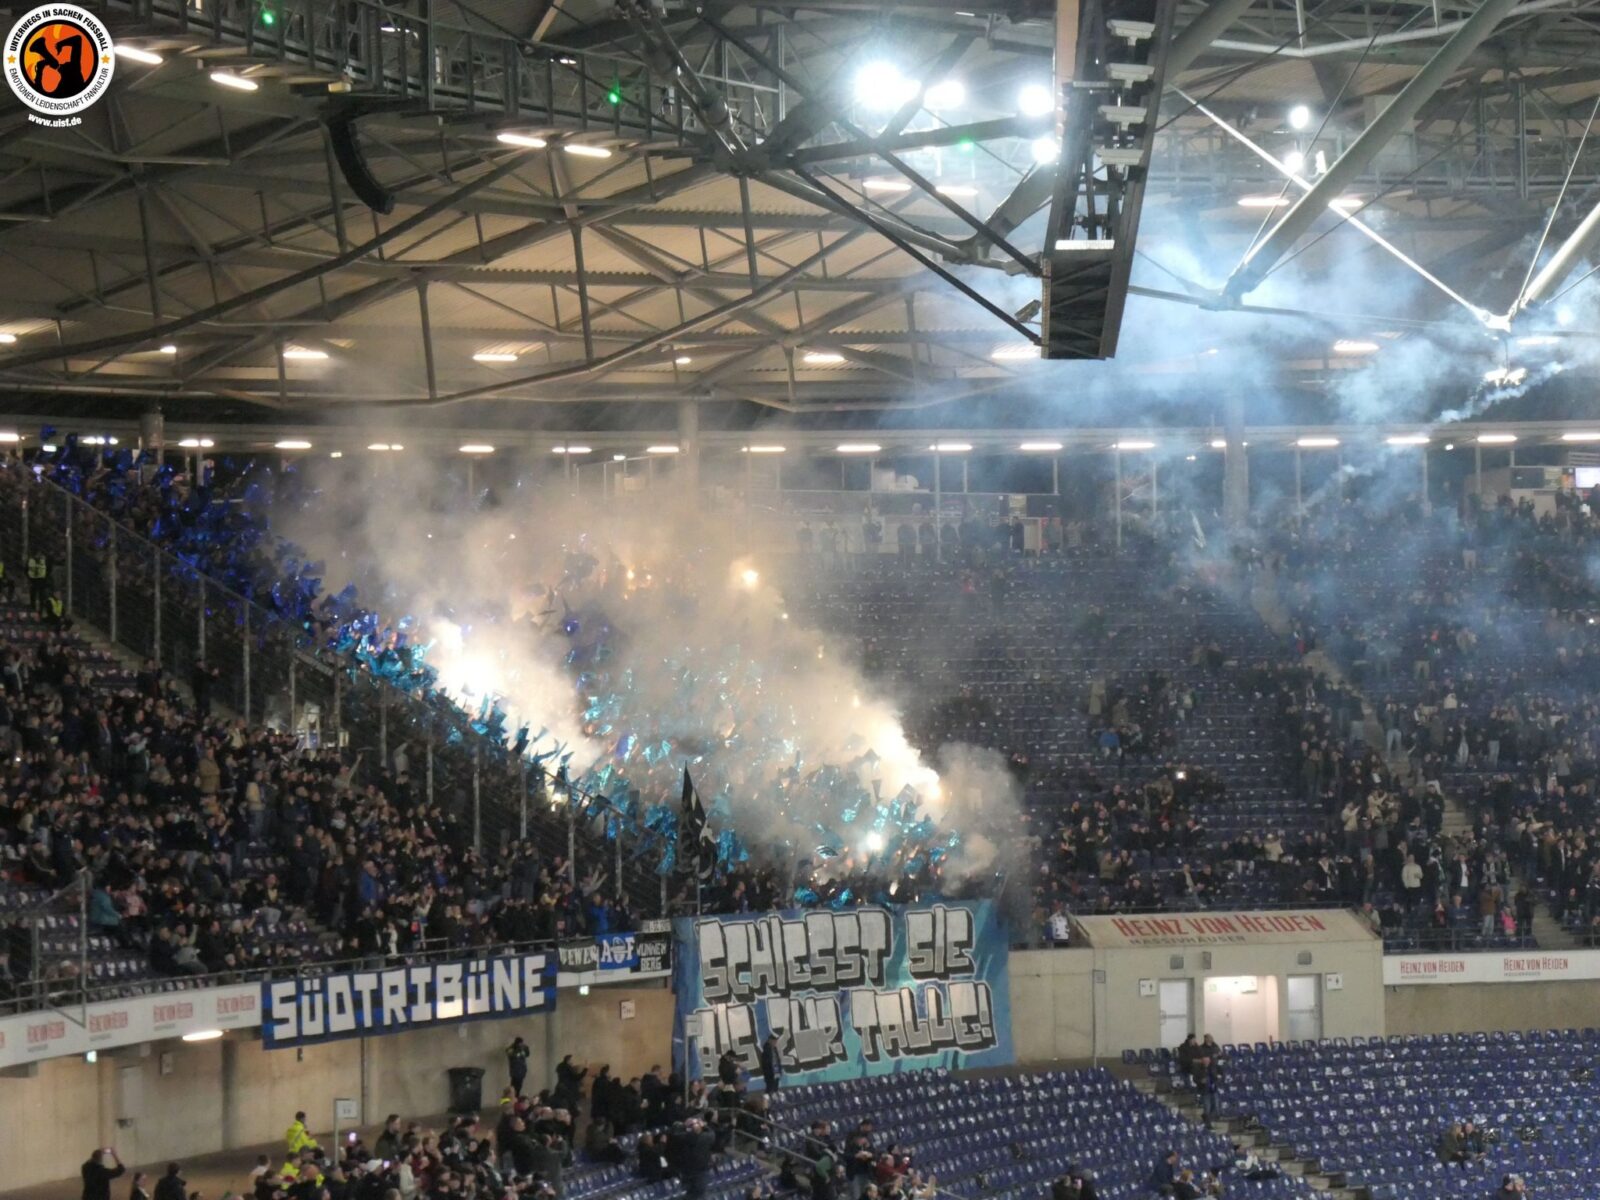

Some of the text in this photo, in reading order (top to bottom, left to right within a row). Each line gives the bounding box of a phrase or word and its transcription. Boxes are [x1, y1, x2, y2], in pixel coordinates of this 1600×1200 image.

[1111, 914, 1327, 937] HEINZ VON HEIDEN
[696, 903, 976, 1002] SCHIESST SIE
[1503, 956, 1568, 971] HEINZ VON HEIDEN
[1400, 960, 1421, 974] HEINZ
[1439, 959, 1465, 973] HEIDEN
[273, 954, 547, 1041] SÜDTRIBÜNE
